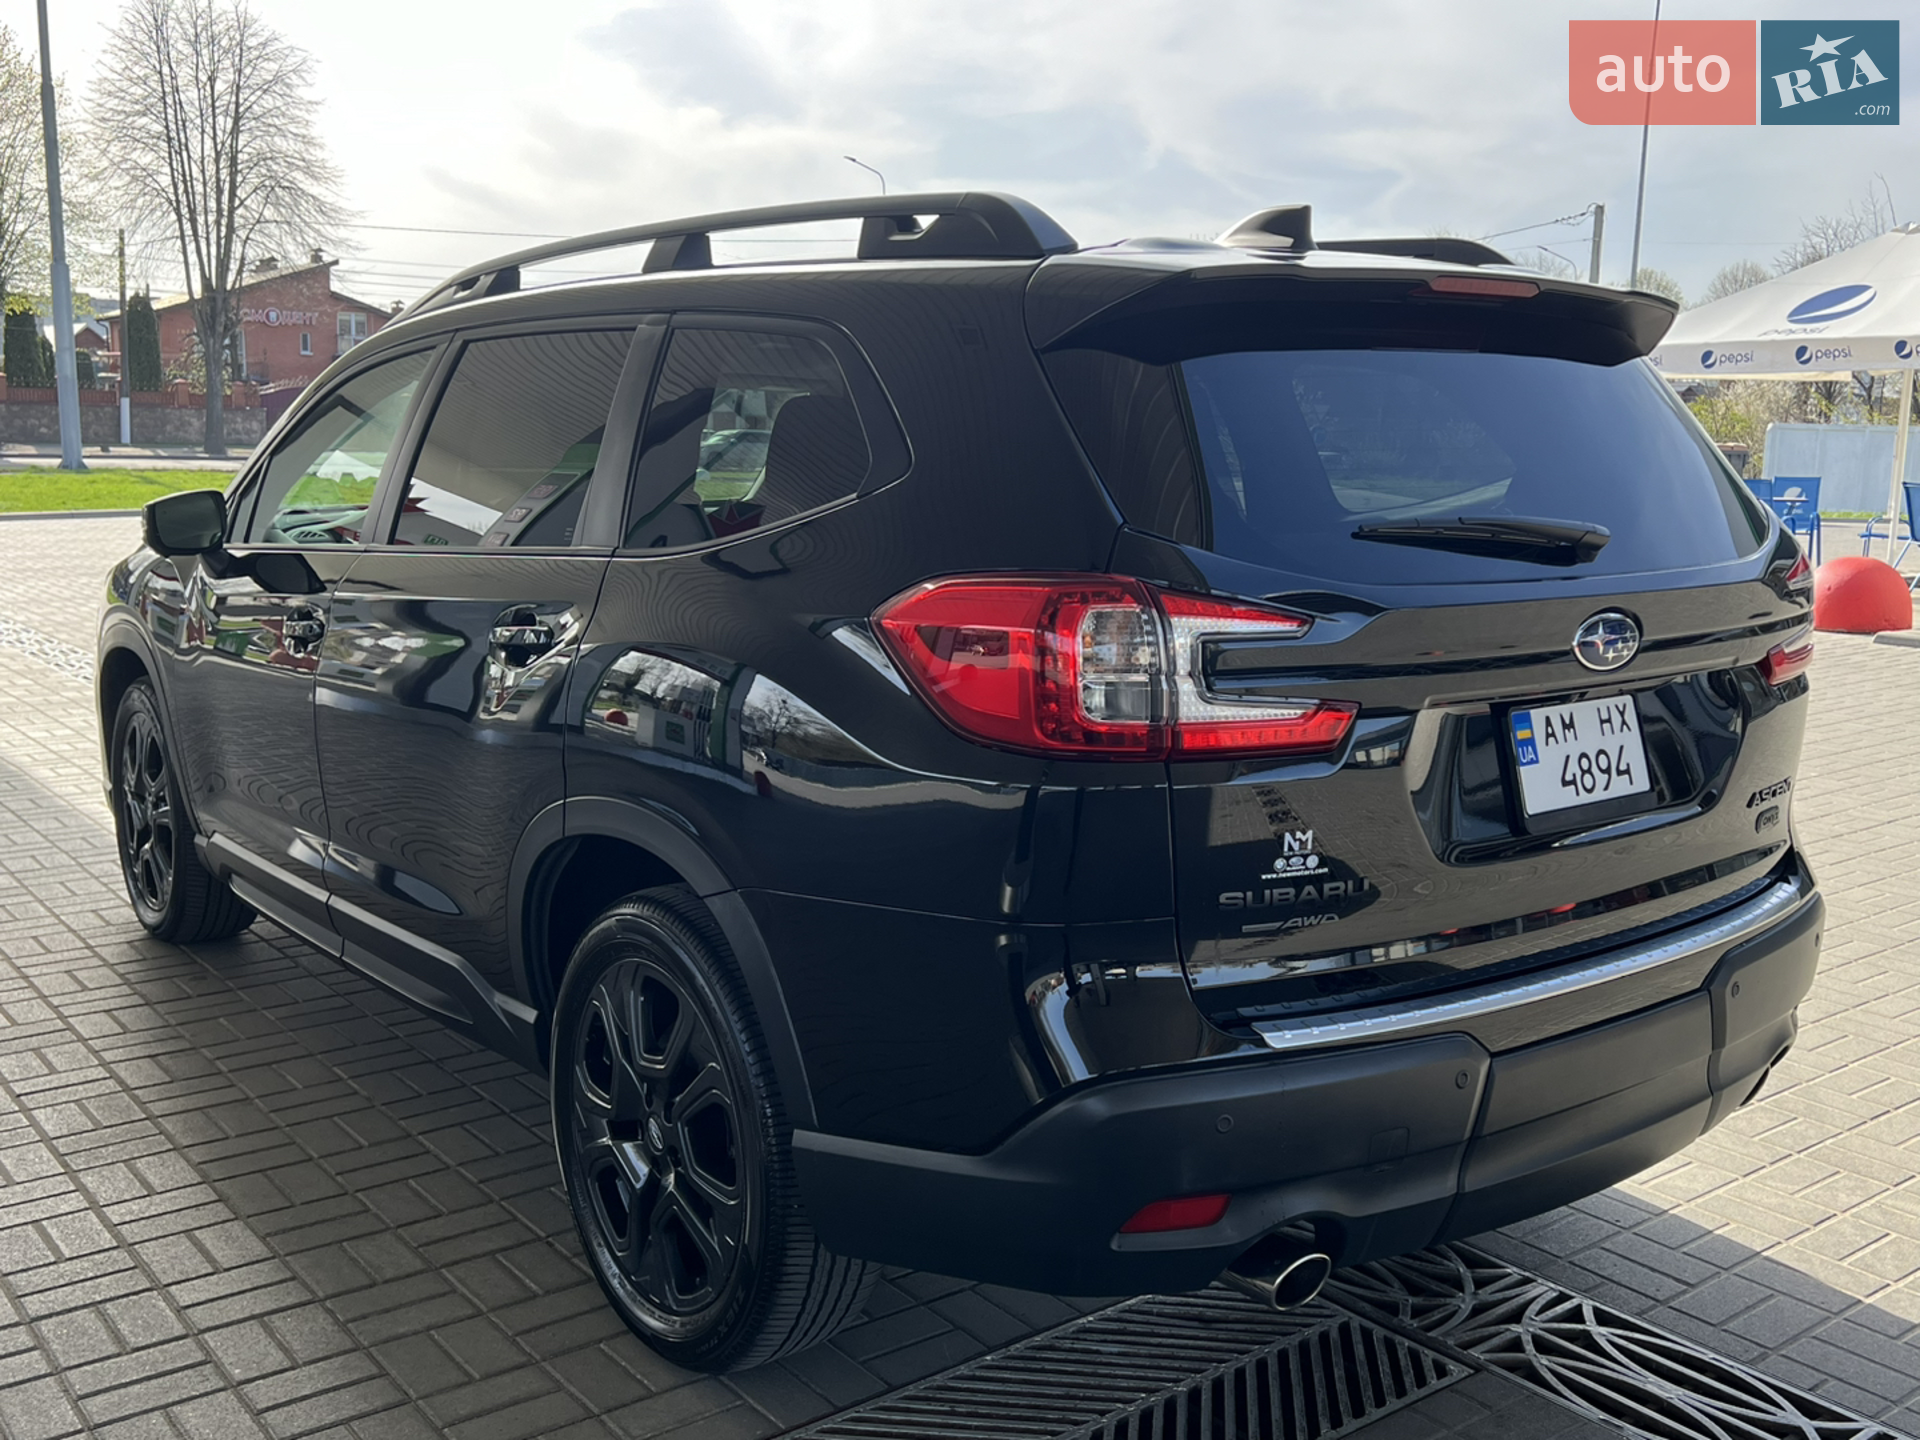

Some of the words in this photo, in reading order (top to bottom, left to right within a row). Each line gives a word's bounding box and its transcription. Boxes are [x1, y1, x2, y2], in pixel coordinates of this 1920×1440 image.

[1718, 350, 1754, 366] pepsi
[1814, 345, 1853, 362] pepsi
[1545, 711, 1578, 747] AM
[1597, 702, 1632, 737] HX
[1518, 745, 1536, 763] UA
[1561, 744, 1633, 797] 4894
[1746, 776, 1792, 808] ASCEN
[1283, 829, 1313, 852] NM
[1261, 867, 1329, 879] www.newmotors.com
[1218, 878, 1372, 911] SUBARU
[1281, 913, 1340, 930] AWD
